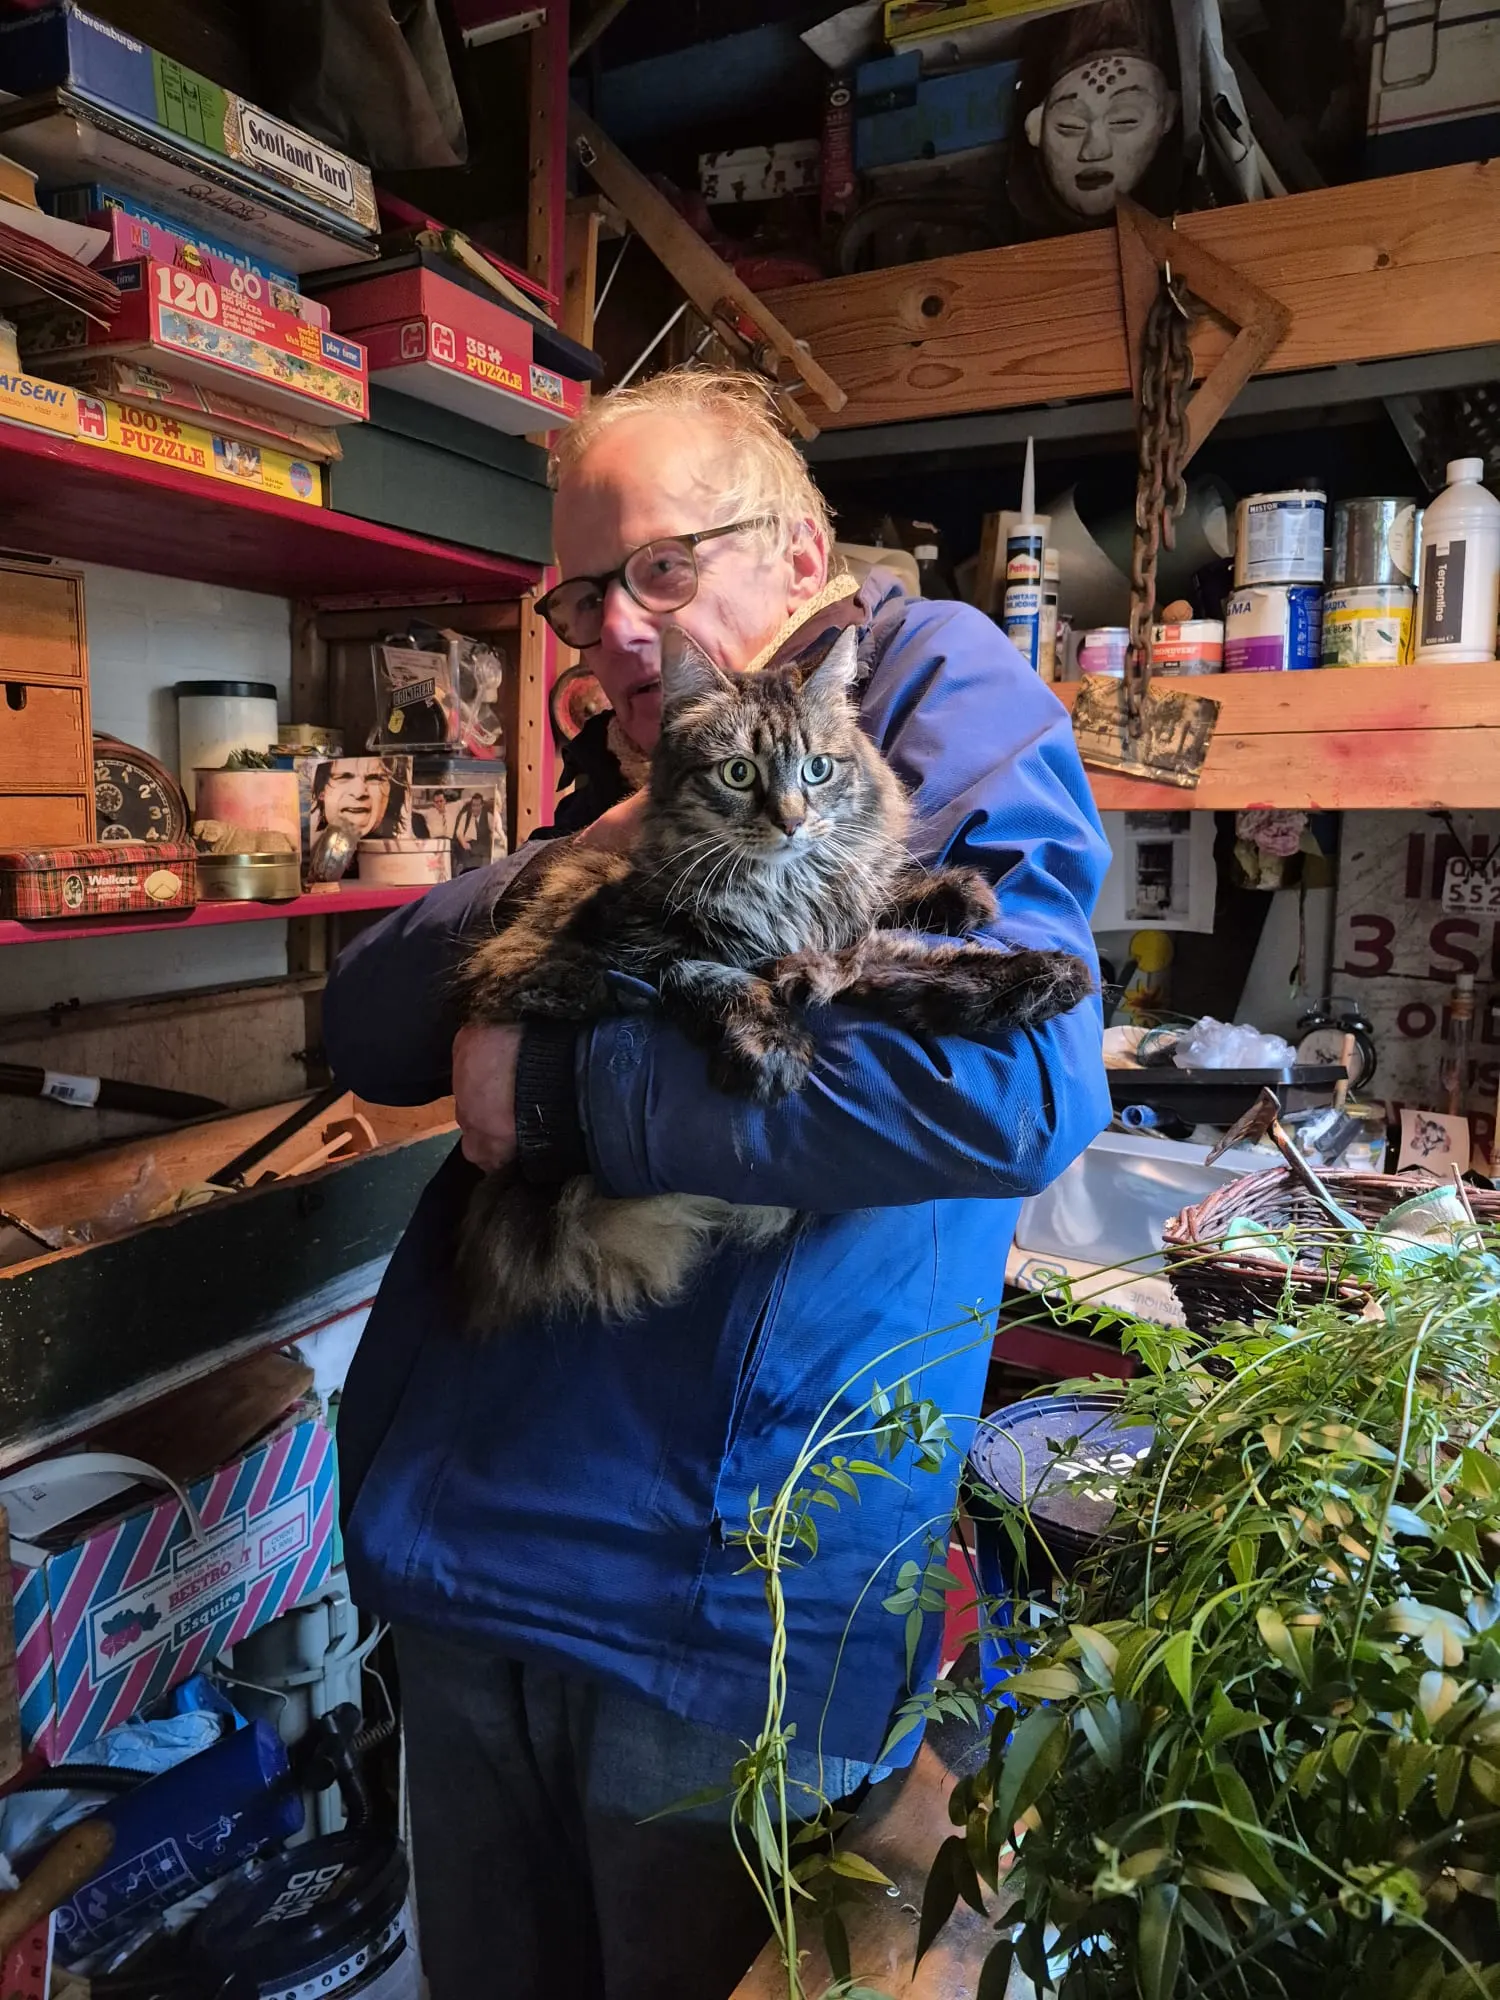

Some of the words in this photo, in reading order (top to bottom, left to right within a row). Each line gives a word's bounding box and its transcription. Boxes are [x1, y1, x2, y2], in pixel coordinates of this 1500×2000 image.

[74, 7, 143, 54] Ravensburger
[248, 119, 314, 175] Scotland
[315, 153, 348, 193] Yard
[130, 224, 150, 249] MB
[156, 267, 219, 319] 120
[230, 267, 262, 300] 60
[326, 341, 340, 357] play
[342, 345, 358, 362] time
[466, 353, 524, 392] PUZZLE
[0, 374, 67, 408] ATSEN!
[118, 403, 158, 433] 100
[120, 426, 206, 469] PUZZLE
[1249, 502, 1278, 514] HISTOR
[1436, 563, 1448, 622] Terpentine
[121, 769, 129, 784] 1
[138, 784, 152, 799] 2
[148, 805, 162, 820] 3
[146, 826, 160, 840] 4
[88, 875, 139, 886] Walkers
[1344, 914, 1397, 979] 3
[1428, 918, 1500, 982] S
[168, 1547, 252, 1610] BEETROT
[180, 1590, 241, 1636] Esquire
